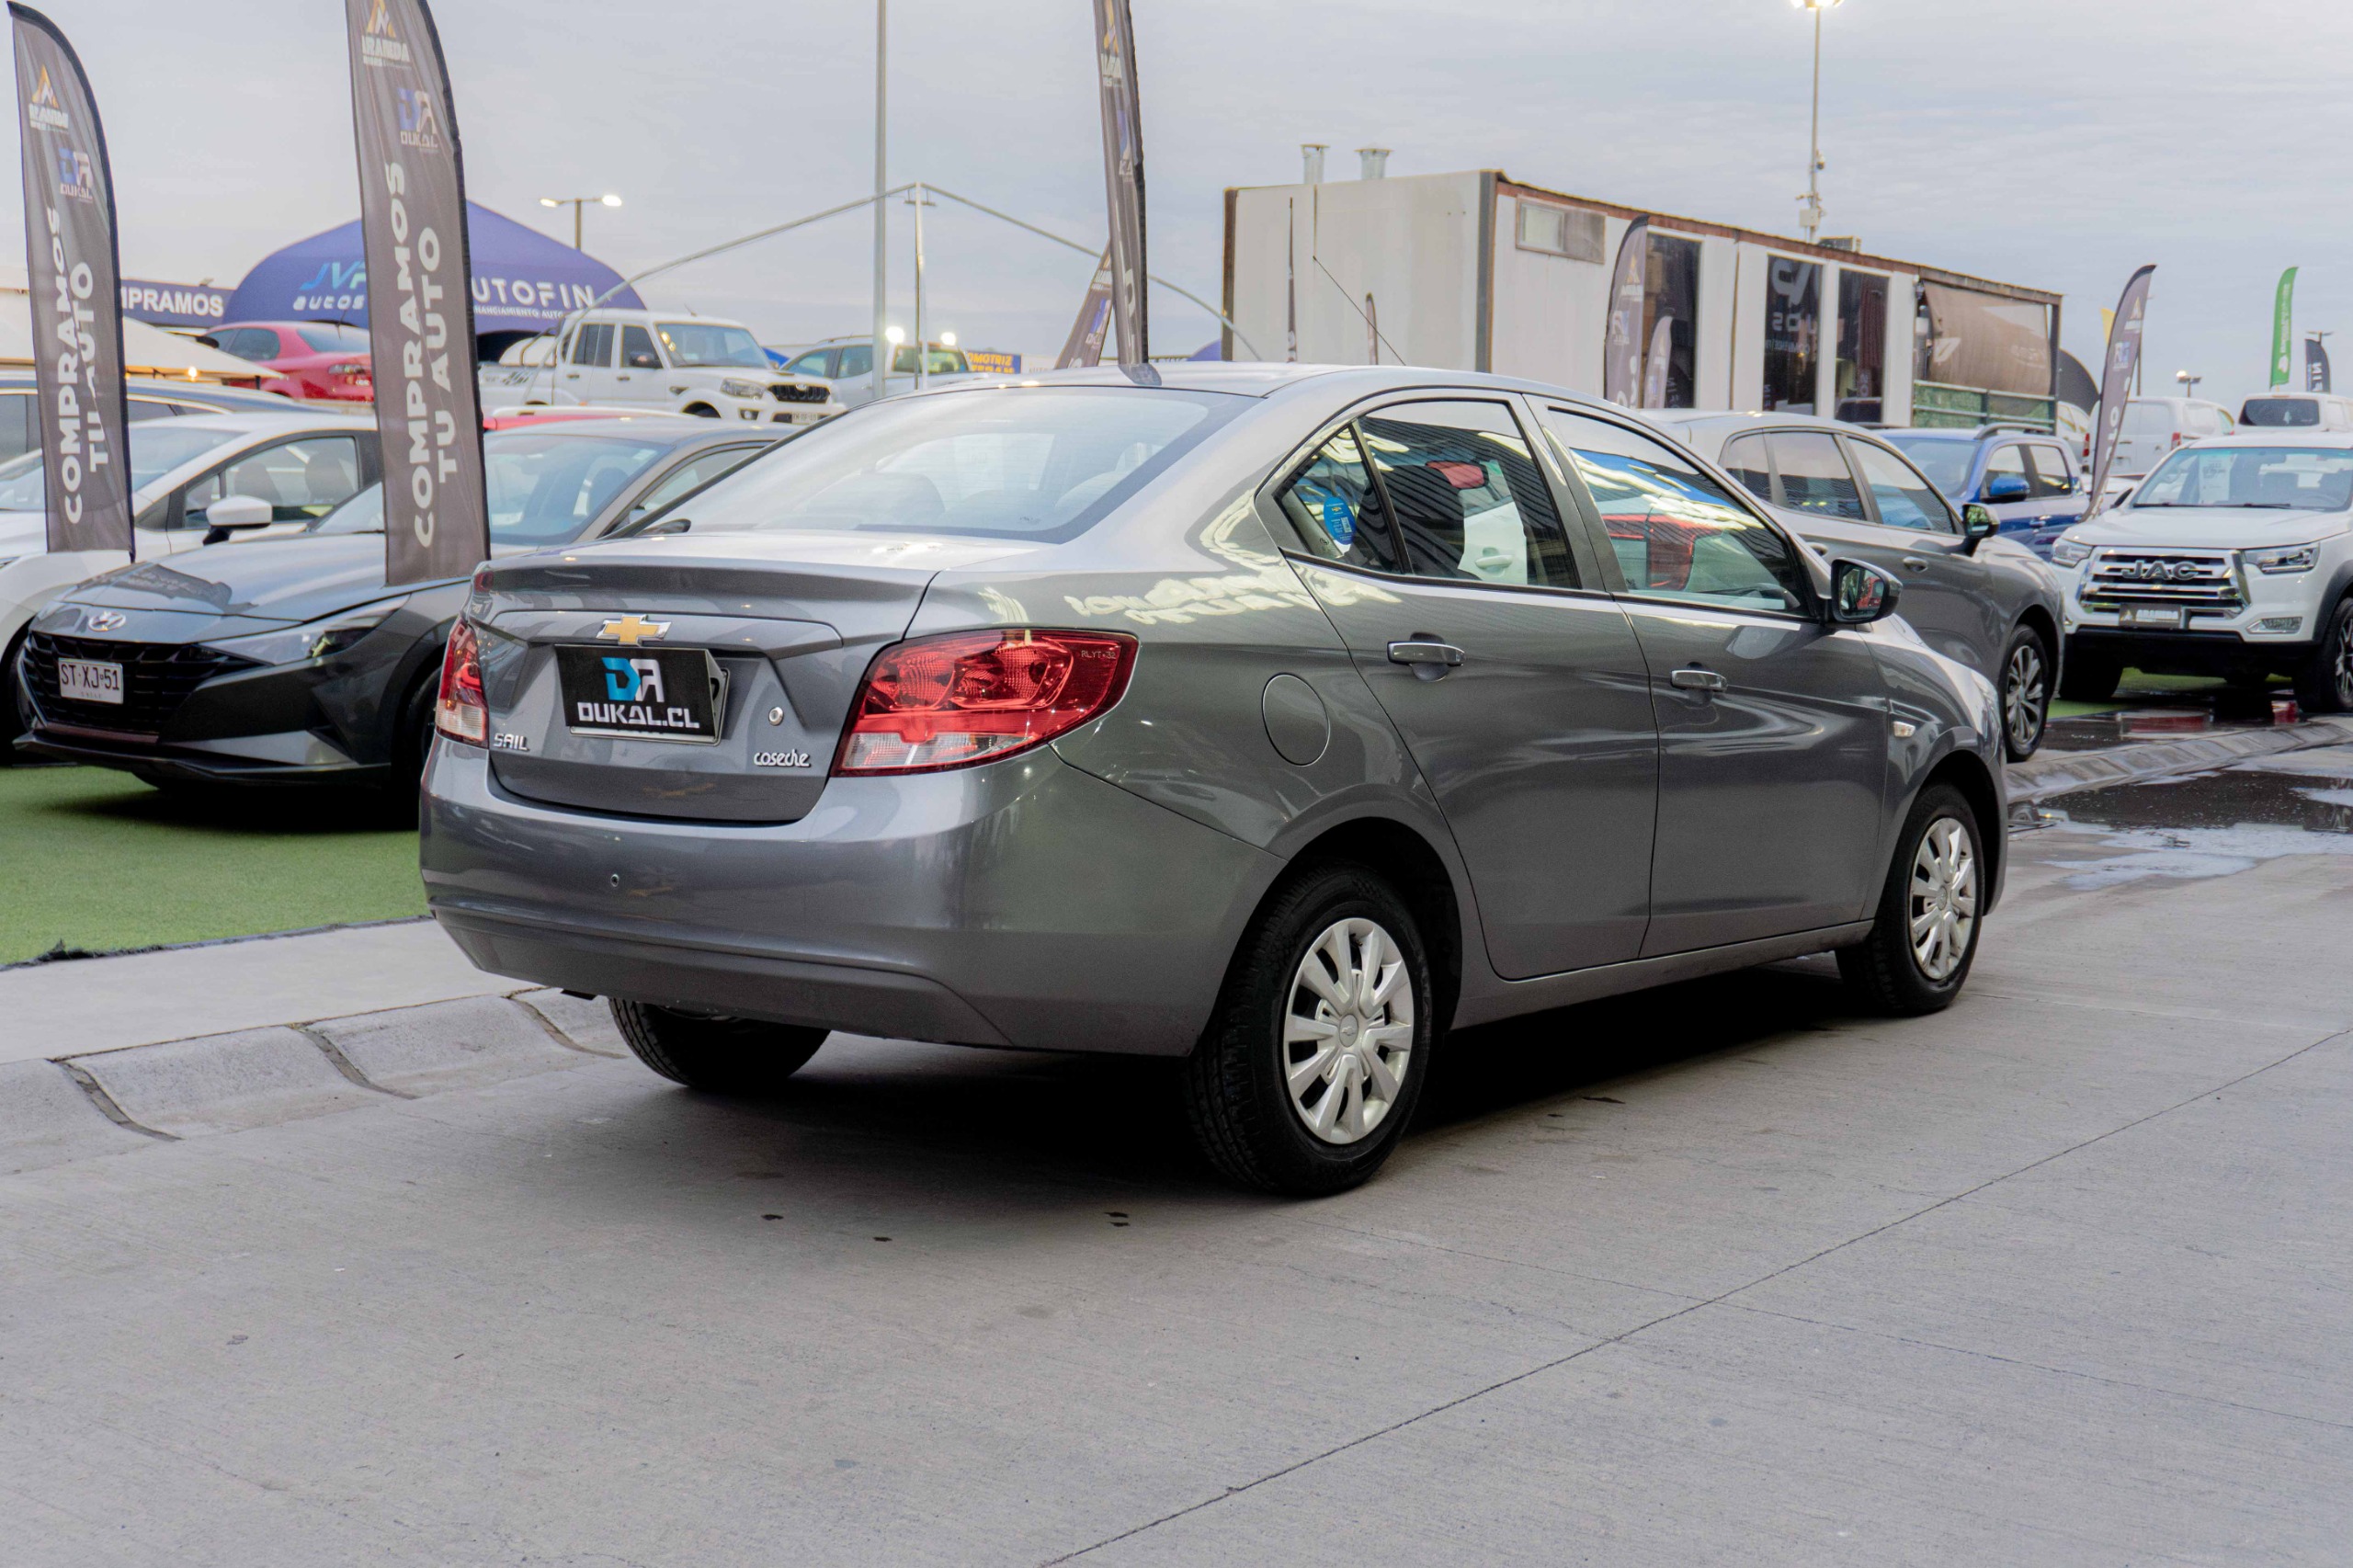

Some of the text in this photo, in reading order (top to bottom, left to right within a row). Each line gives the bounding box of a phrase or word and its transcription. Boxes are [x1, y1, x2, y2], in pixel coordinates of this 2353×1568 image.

[47, 206, 83, 524] COMPRAMOS
[384, 162, 434, 548] COMPRAMOS
[418, 227, 458, 483] TU AUTO
[2120, 560, 2199, 581] JAC
[493, 733, 530, 752] SAIL
[576, 701, 700, 729] DUKAL.CL
